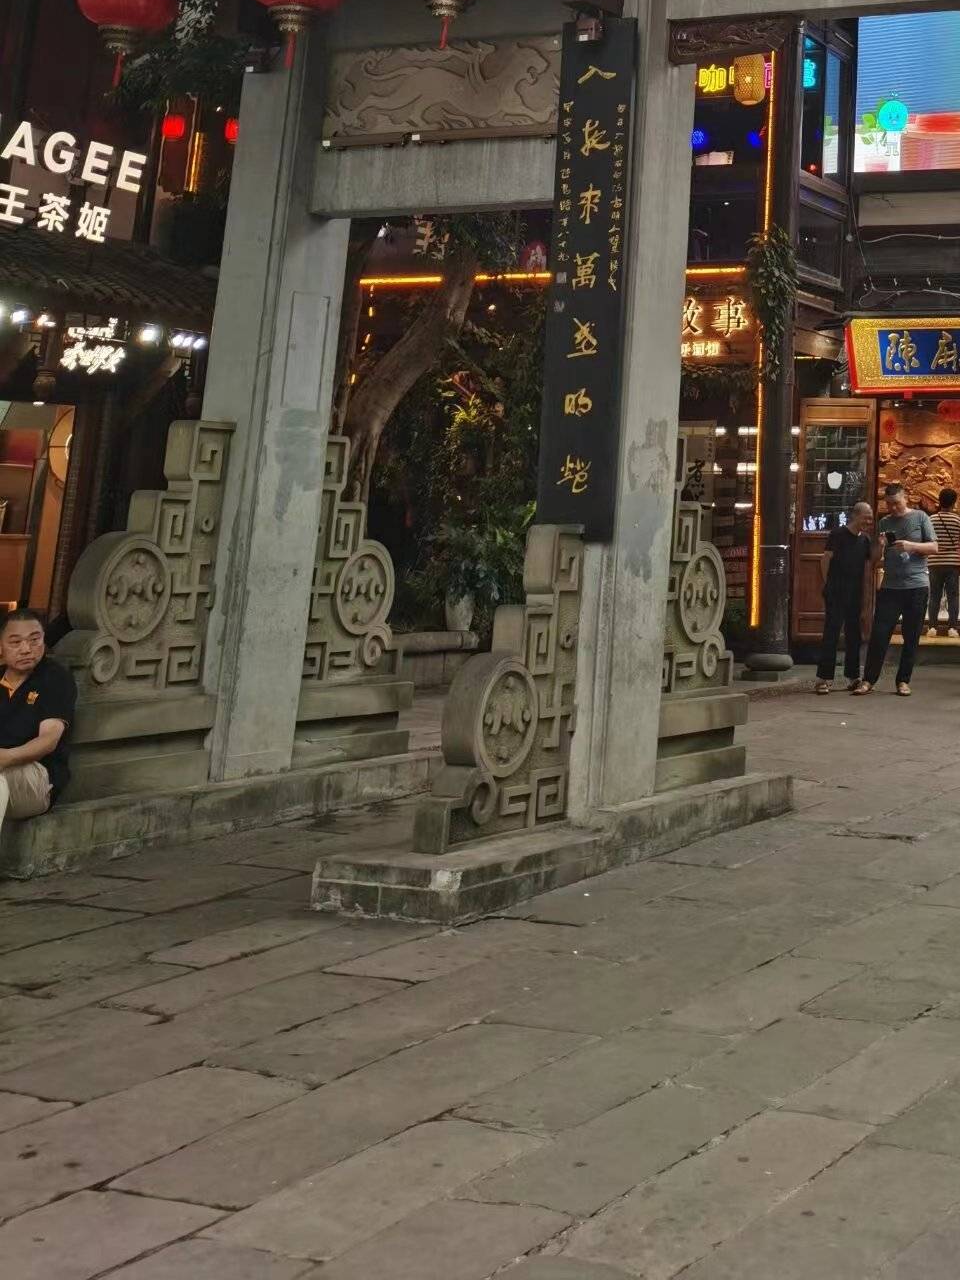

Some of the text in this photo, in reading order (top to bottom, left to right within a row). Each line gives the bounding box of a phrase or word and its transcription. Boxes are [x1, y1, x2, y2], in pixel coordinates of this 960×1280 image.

[0, 120, 147, 193] AGEE
[0, 182, 111, 244] 王茶姬
